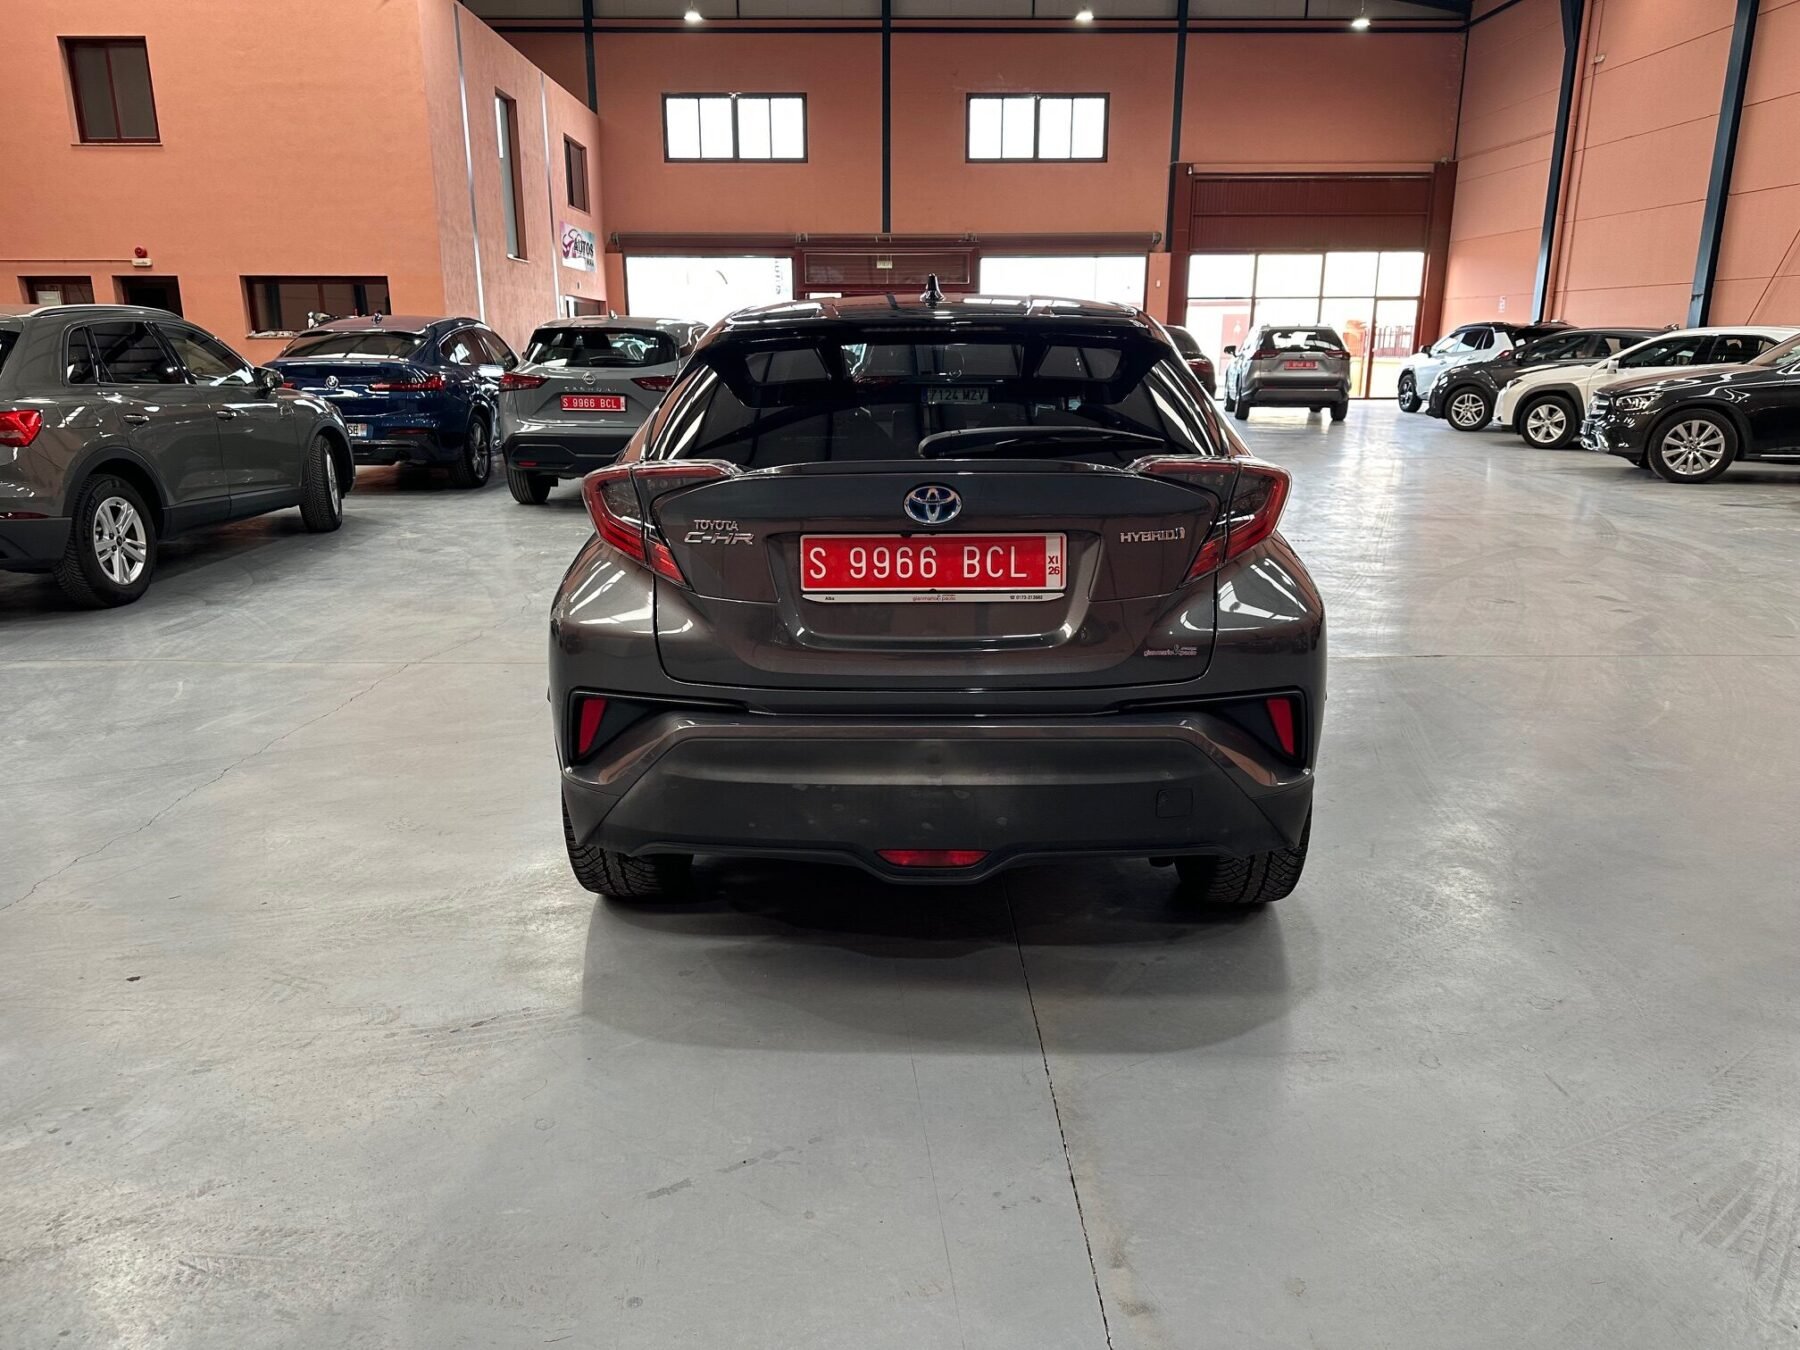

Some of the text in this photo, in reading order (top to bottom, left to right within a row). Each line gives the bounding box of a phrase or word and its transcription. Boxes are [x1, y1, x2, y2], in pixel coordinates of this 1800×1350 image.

[562, 398, 569, 407] S
[572, 398, 596, 408] 9966
[600, 398, 617, 408] BCL
[693, 519, 739, 531] TOYOTA
[684, 531, 754, 545] C-HR
[1119, 529, 1176, 543] HYBRID
[809, 545, 1028, 579] S 9966 BCL
[1047, 555, 1059, 565] XI
[1047, 565, 1060, 575] 26
